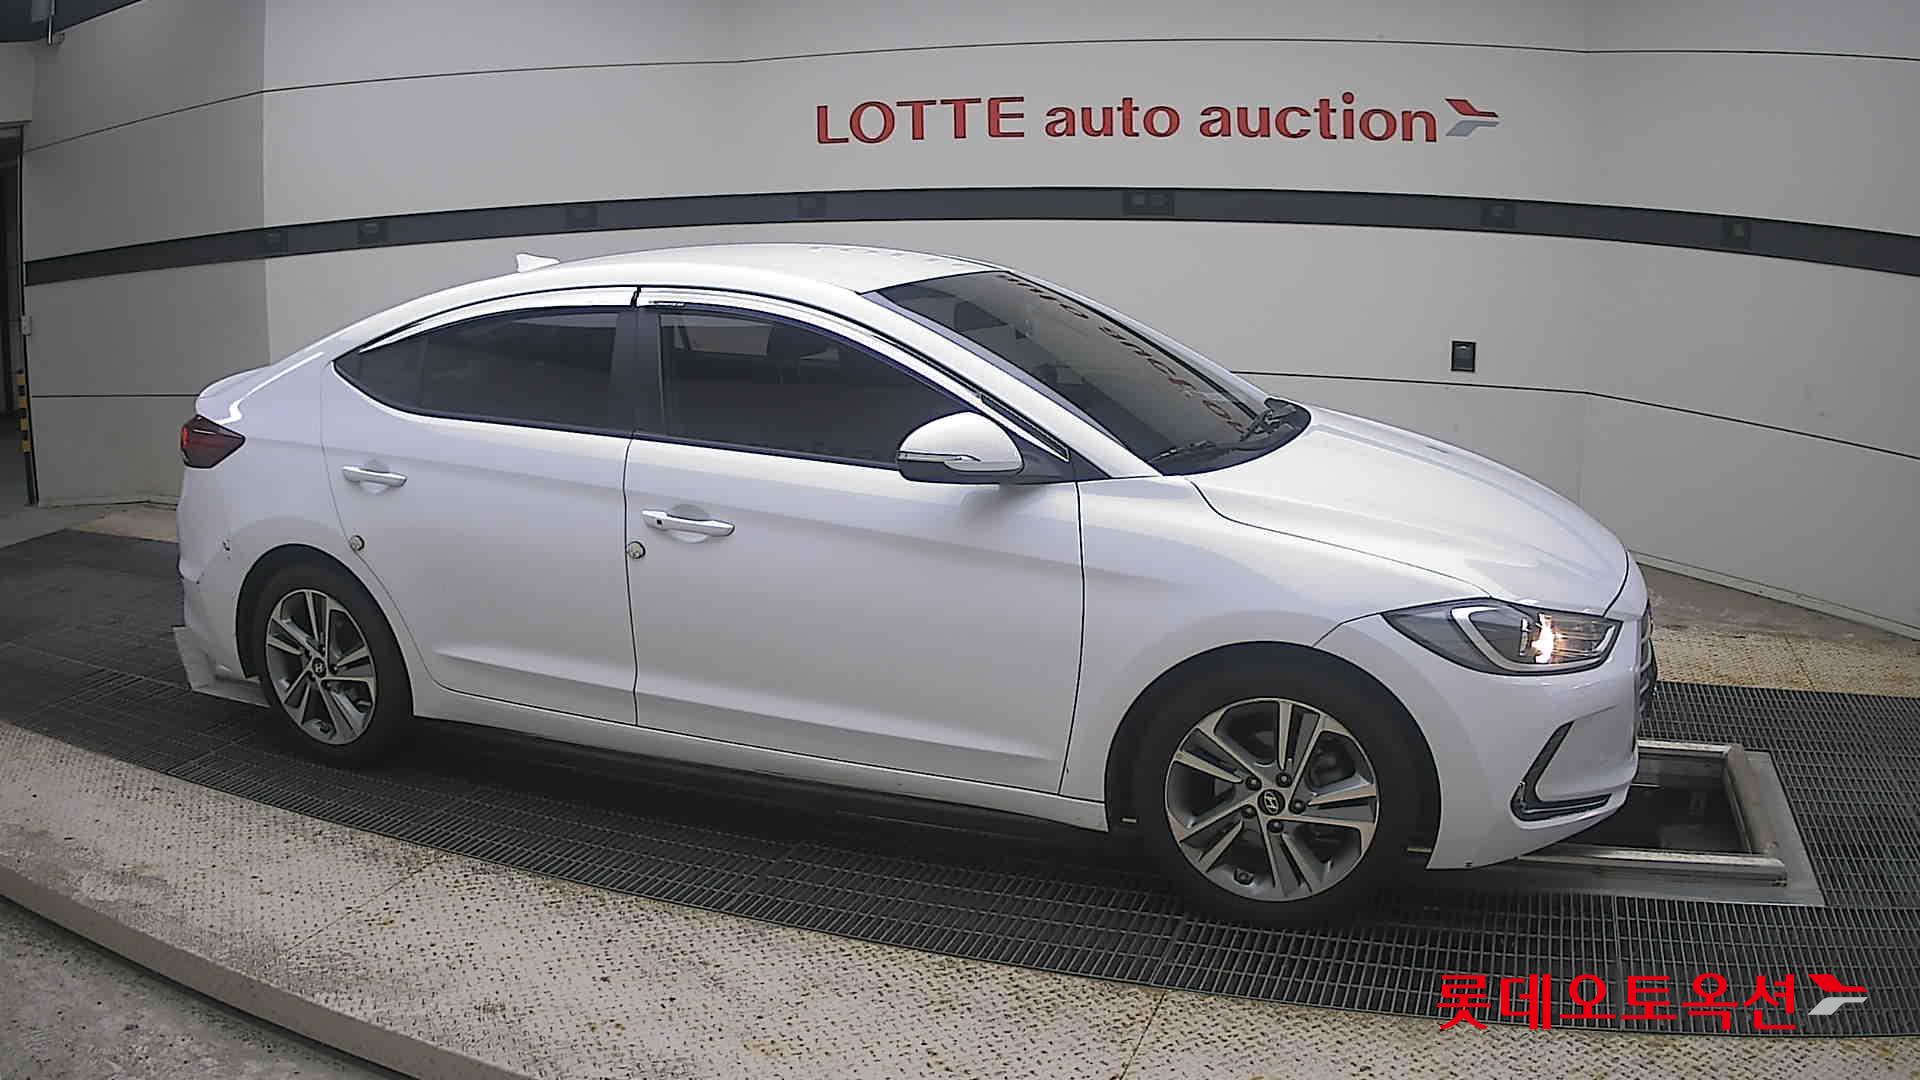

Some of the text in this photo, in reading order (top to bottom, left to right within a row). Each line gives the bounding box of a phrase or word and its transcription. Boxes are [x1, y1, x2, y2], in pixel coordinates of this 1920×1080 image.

[816, 91, 1438, 144] LOTTE auto auction
